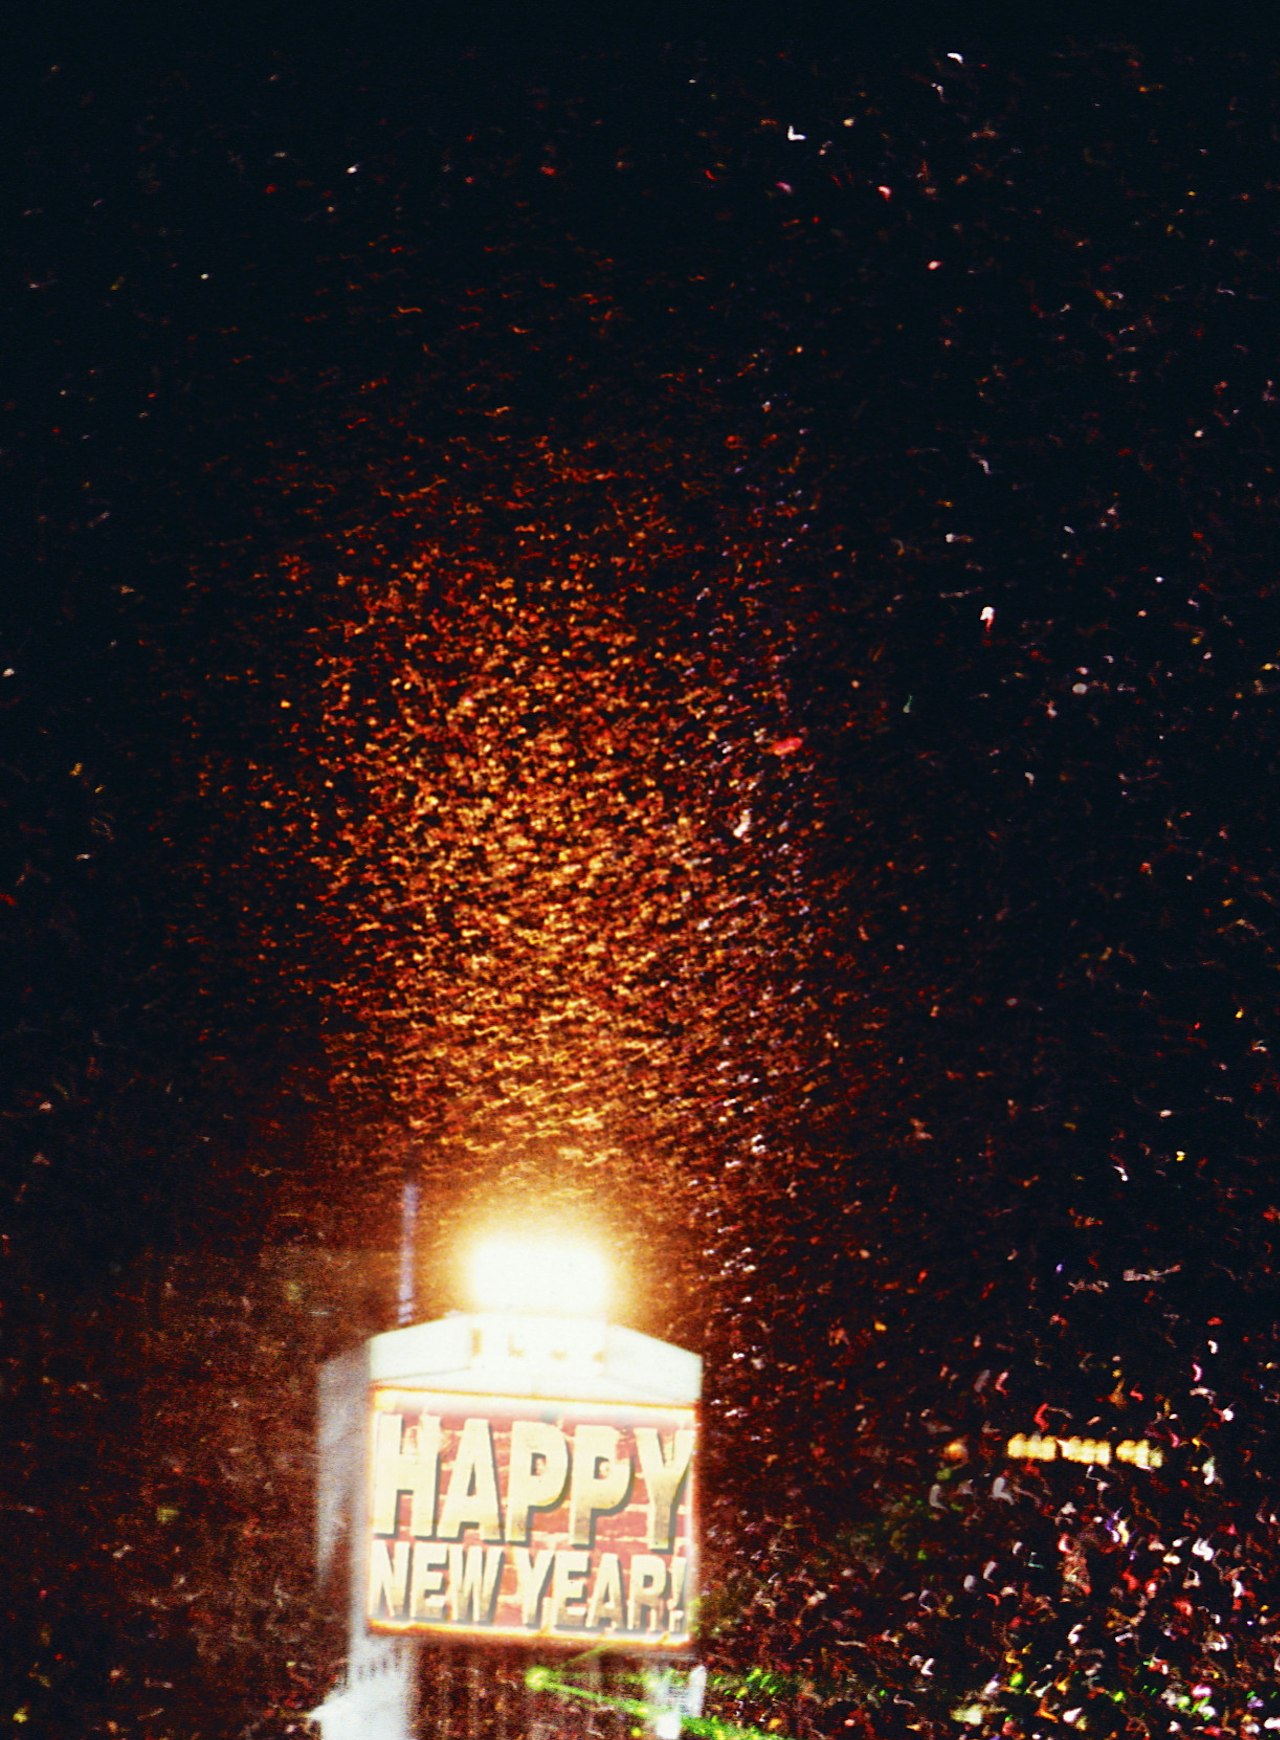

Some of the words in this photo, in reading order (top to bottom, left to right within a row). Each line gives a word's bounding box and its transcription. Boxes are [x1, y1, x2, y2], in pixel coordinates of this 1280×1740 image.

[373, 1414, 695, 1553] HAPPY
[369, 1541, 504, 1624] NEW
[513, 1547, 688, 1635] YEAR!
